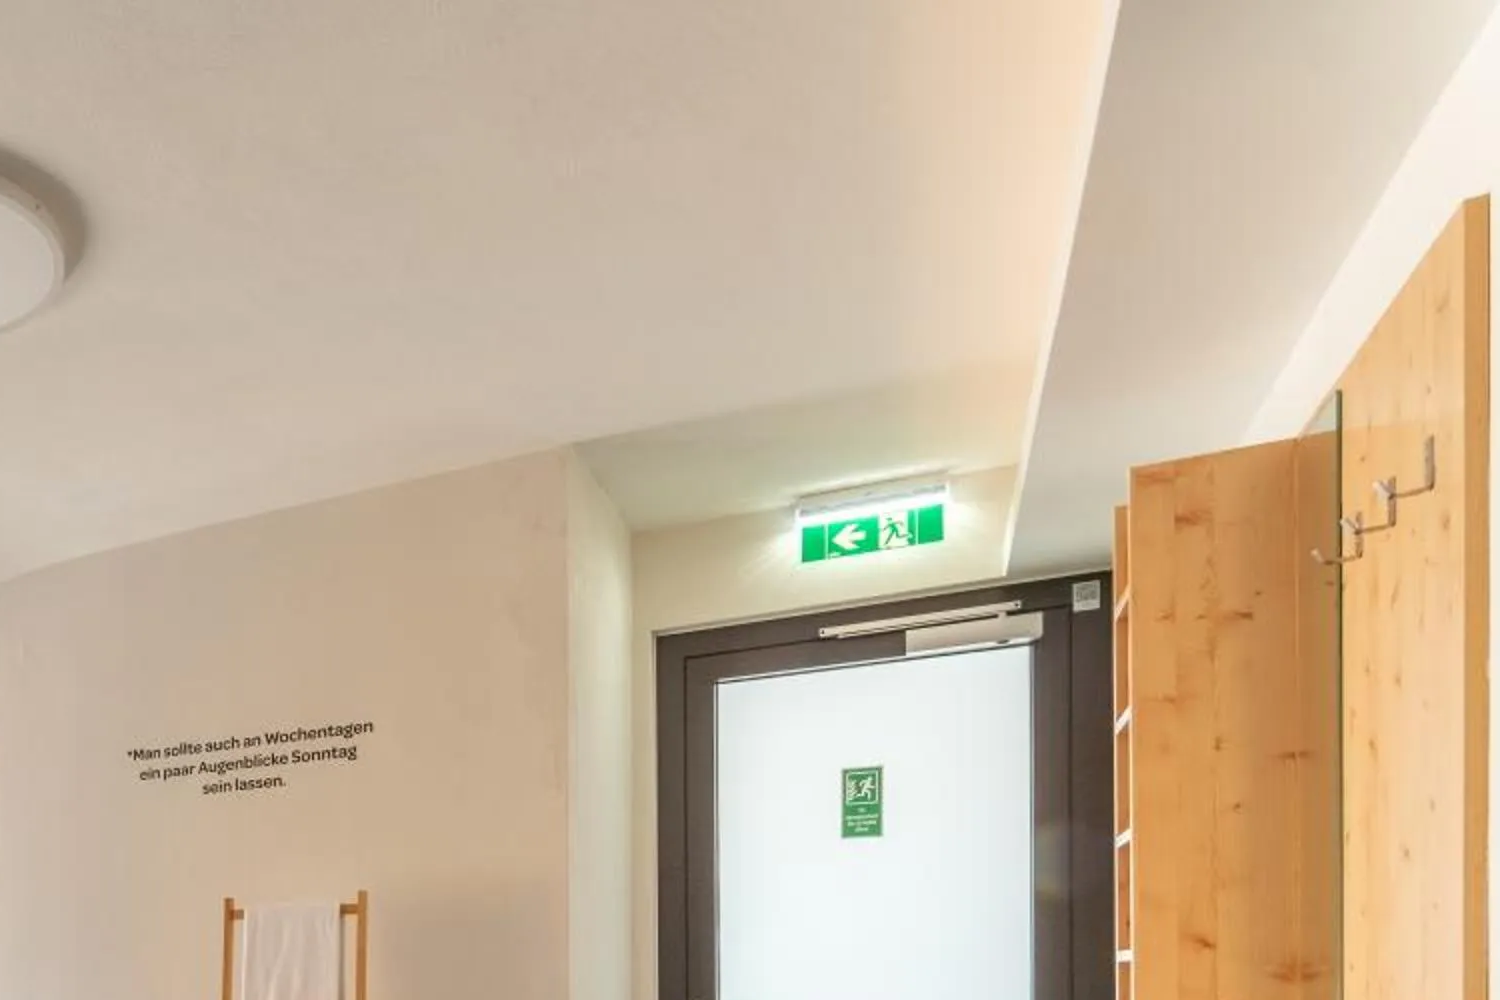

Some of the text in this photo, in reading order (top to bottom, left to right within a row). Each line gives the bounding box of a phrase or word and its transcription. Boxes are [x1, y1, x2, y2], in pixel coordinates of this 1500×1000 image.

[163, 742, 202, 758] sollte
[204, 736, 241, 752] auch
[243, 735, 261, 748] an
[264, 722, 374, 745] Wochentagen
[163, 765, 196, 781] paar
[198, 753, 289, 775] Augenblicke
[291, 745, 357, 763] Sonntag
[202, 777, 286, 795] sein lassen.
